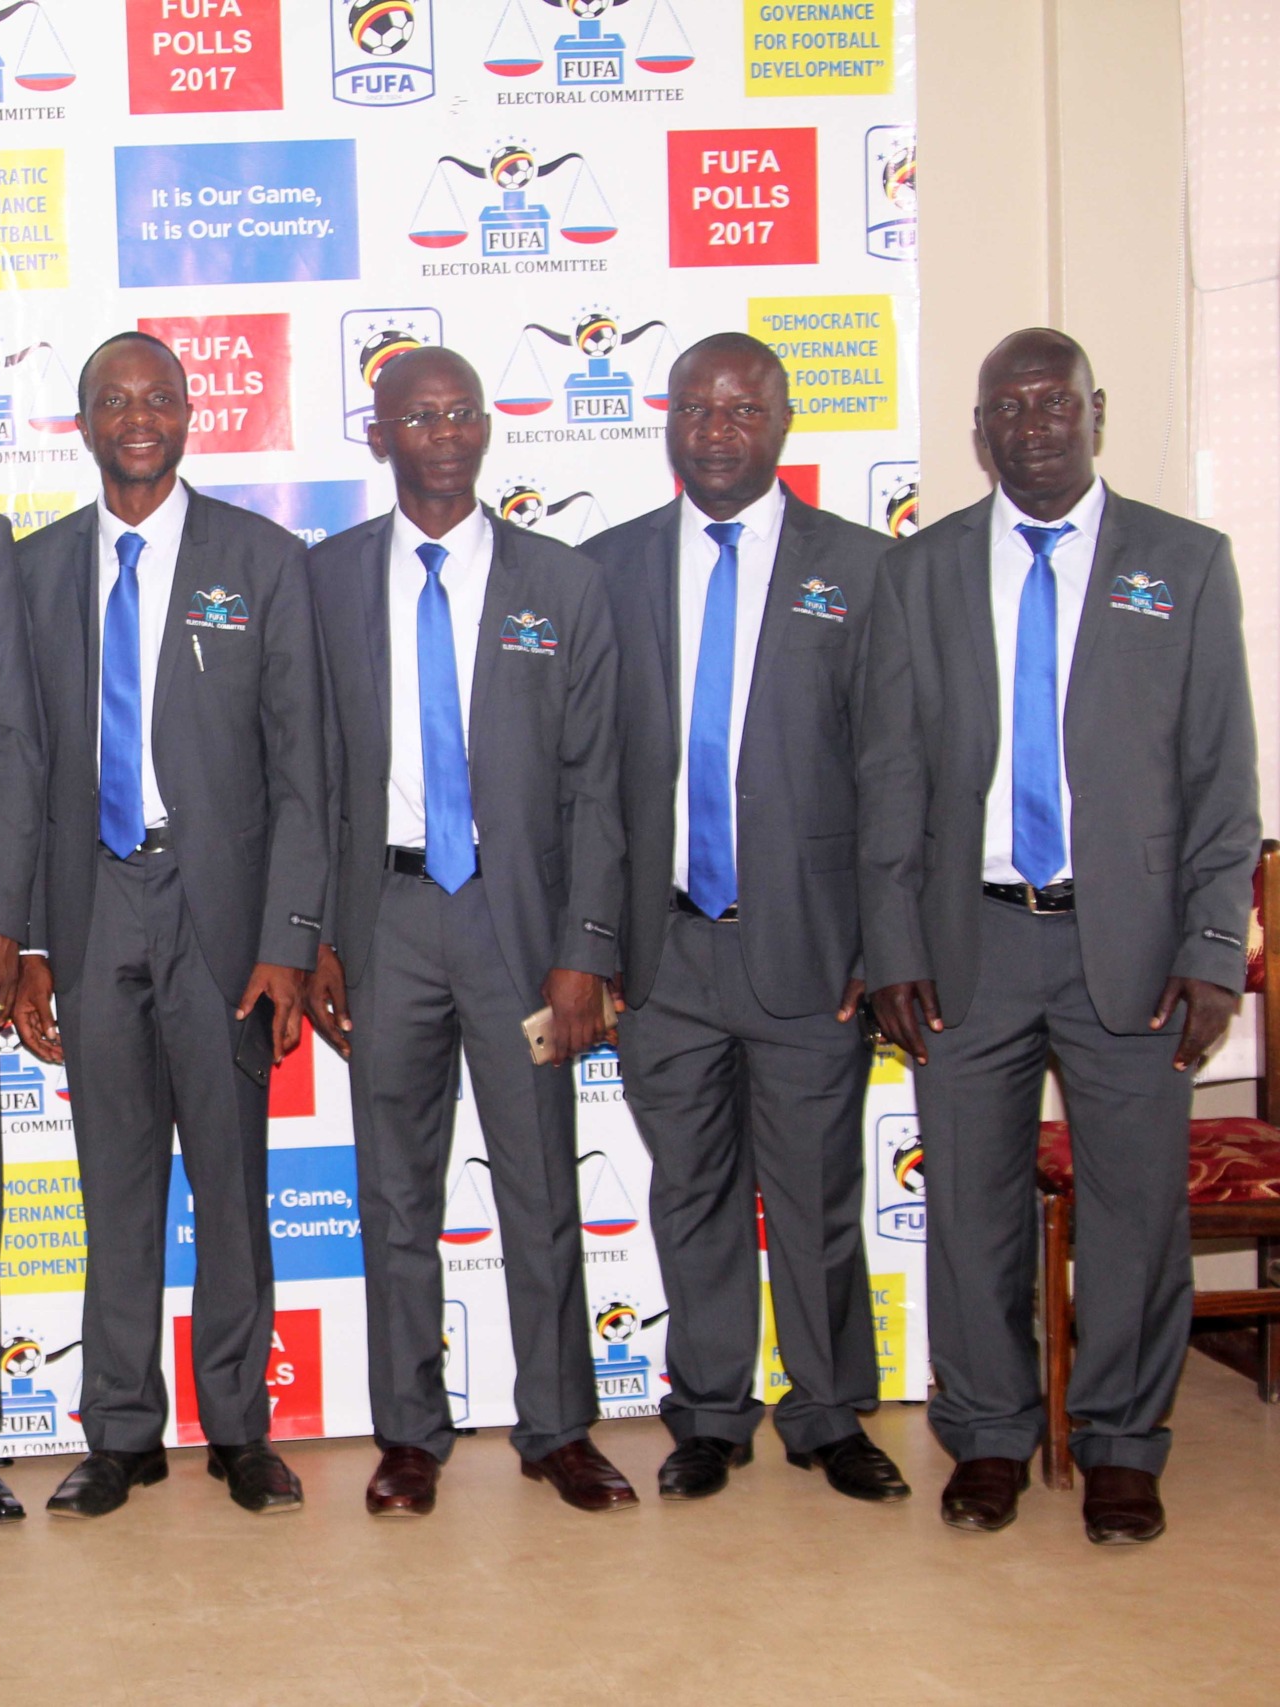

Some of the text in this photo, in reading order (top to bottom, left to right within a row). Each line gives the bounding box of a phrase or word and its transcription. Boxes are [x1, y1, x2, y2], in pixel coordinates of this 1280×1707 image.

[162, 0, 242, 18] FUFA
[760, 4, 874, 22] GOVERNANCE
[154, 30, 252, 55] POLLS
[754, 32, 879, 50] FOR FOOTBALL
[564, 61, 617, 79] FUFA
[751, 60, 884, 79] DEVELOPMENT”
[170, 67, 235, 91] 2017
[352, 75, 415, 93] FUFA
[497, 88, 684, 105] ELECTORAL COMMITTEE
[702, 150, 780, 173] FUFA
[152, 184, 322, 207] It is Our Game,
[692, 185, 790, 209] POLLS
[142, 216, 334, 241] It is Our Country.
[709, 222, 773, 245] 2017
[488, 231, 542, 249] FUFA
[885, 230, 915, 248] FU
[422, 259, 607, 277] ELECTORAL COMMITTEE
[762, 313, 880, 331] “DEMOCRATIC
[175, 336, 253, 361] FUFA
[187, 372, 263, 396] OLLS
[796, 369, 884, 386] FOOTBALL
[574, 399, 627, 416] FUFA
[789, 396, 889, 414] ELOPMENT”
[188, 409, 248, 433] 2017
[507, 426, 667, 444] ELECTORAL COMMIT
[587, 1063, 621, 1080] FU
[0, 1092, 37, 1109] UFA
[11, 1119, 73, 1133] COMMIT
[280, 1189, 352, 1208] Game,
[895, 1213, 925, 1230] FU
[178, 1219, 363, 1243] It Country.
[448, 1258, 504, 1272] ELECTO
[583, 1250, 628, 1263] ITTEE
[0, 1257, 87, 1278] ELOPMENT
[24, 1441, 87, 1454] COMMIT
